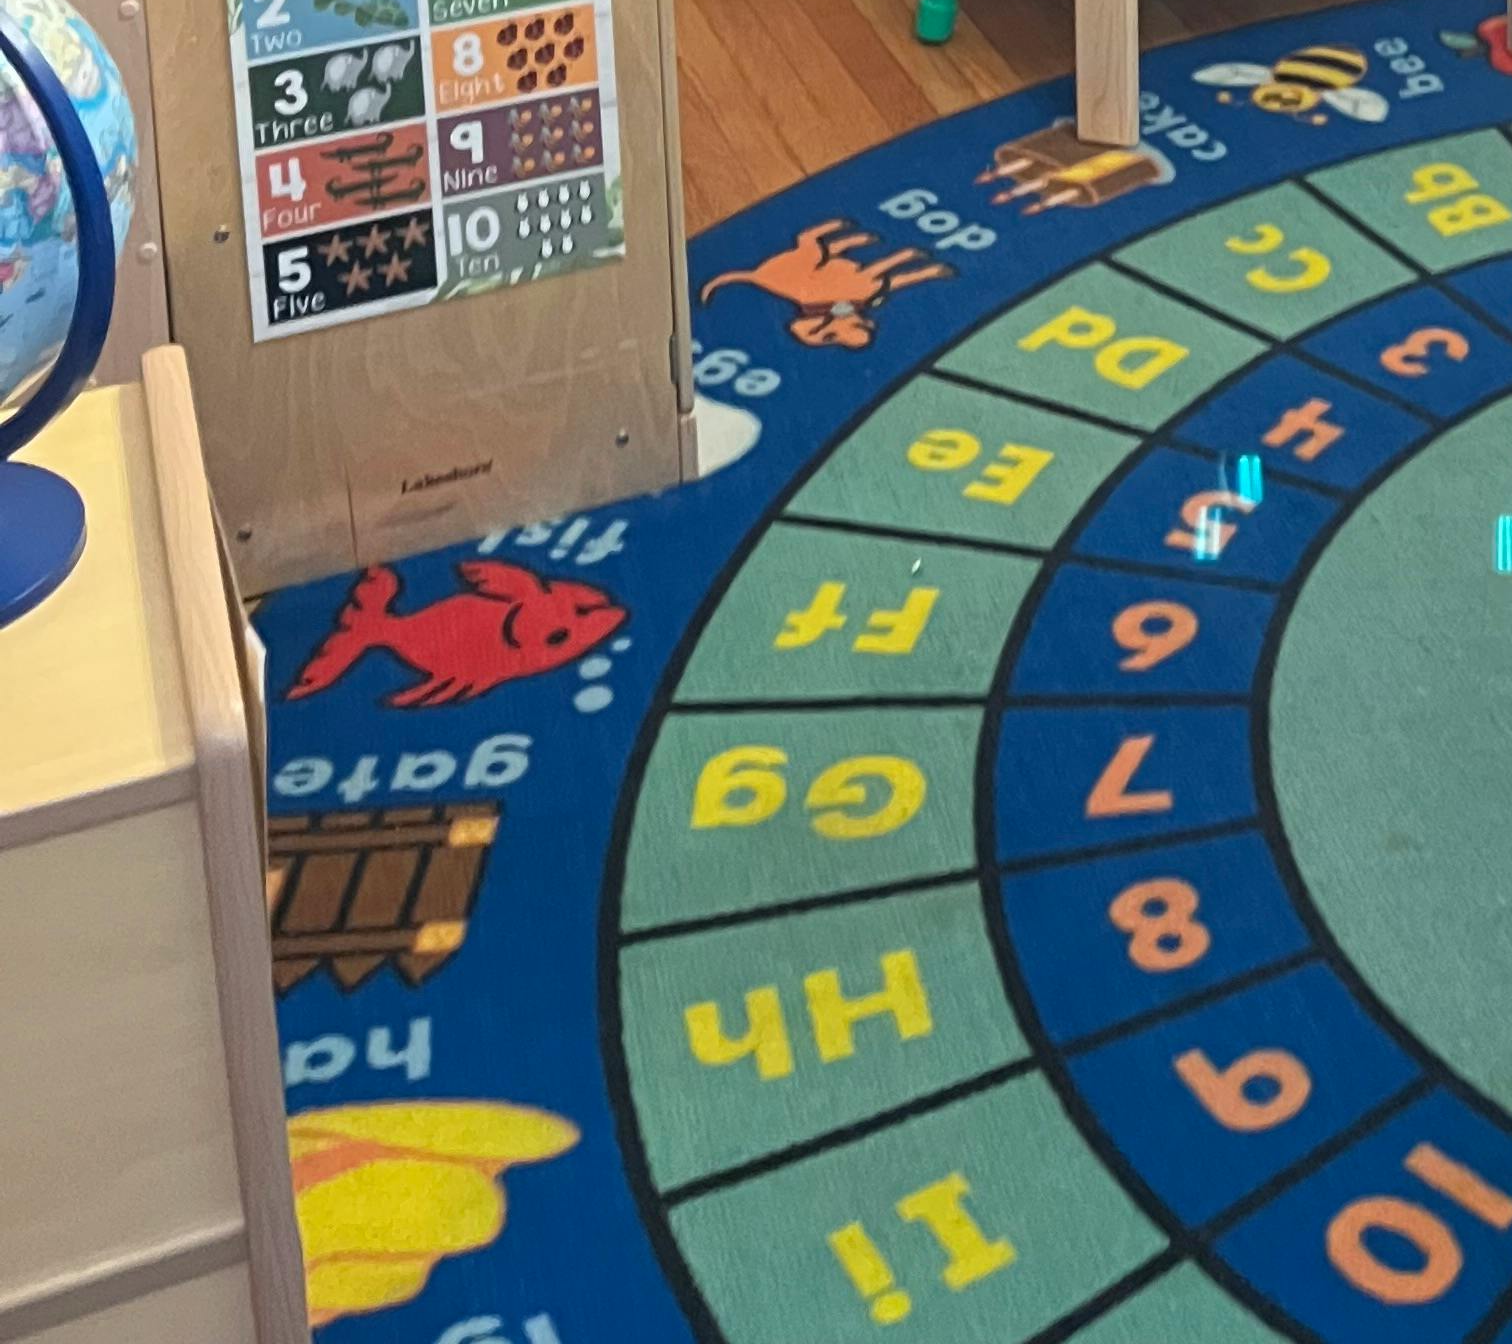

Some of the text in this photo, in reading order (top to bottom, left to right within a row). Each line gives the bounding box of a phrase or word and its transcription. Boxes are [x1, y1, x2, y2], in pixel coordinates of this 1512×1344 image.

[452, 33, 485, 76] 8
[1373, 35, 1444, 100] bee
[273, 69, 309, 116] 3
[439, 69, 506, 105] Eight
[254, 111, 334, 145] Three
[449, 120, 485, 165] 9
[268, 157, 307, 202] 4
[443, 164, 499, 194] Nine
[261, 202, 321, 232] Four
[447, 206, 500, 258] 10
[879, 188, 998, 251] dog
[277, 247, 312, 294] 5
[1224, 223, 1332, 293] Cc
[272, 291, 326, 320] Five
[692, 340, 781, 397] eg
[1016, 305, 1190, 390] Dd
[1379, 326, 1470, 376] 3
[1261, 397, 1345, 461] 4
[906, 428, 1055, 506] Ee
[773, 580, 942, 655] Ff
[1111, 599, 1198, 672] 6
[274, 733, 534, 803] gate
[690, 744, 928, 842] Gg
[1084, 734, 1174, 819] 7
[1108, 876, 1212, 974] 8
[683, 947, 935, 1081] Hh
[284, 1016, 432, 1087] ha
[1172, 1047, 1313, 1132] 9
[826, 1168, 1018, 1327] Ii
